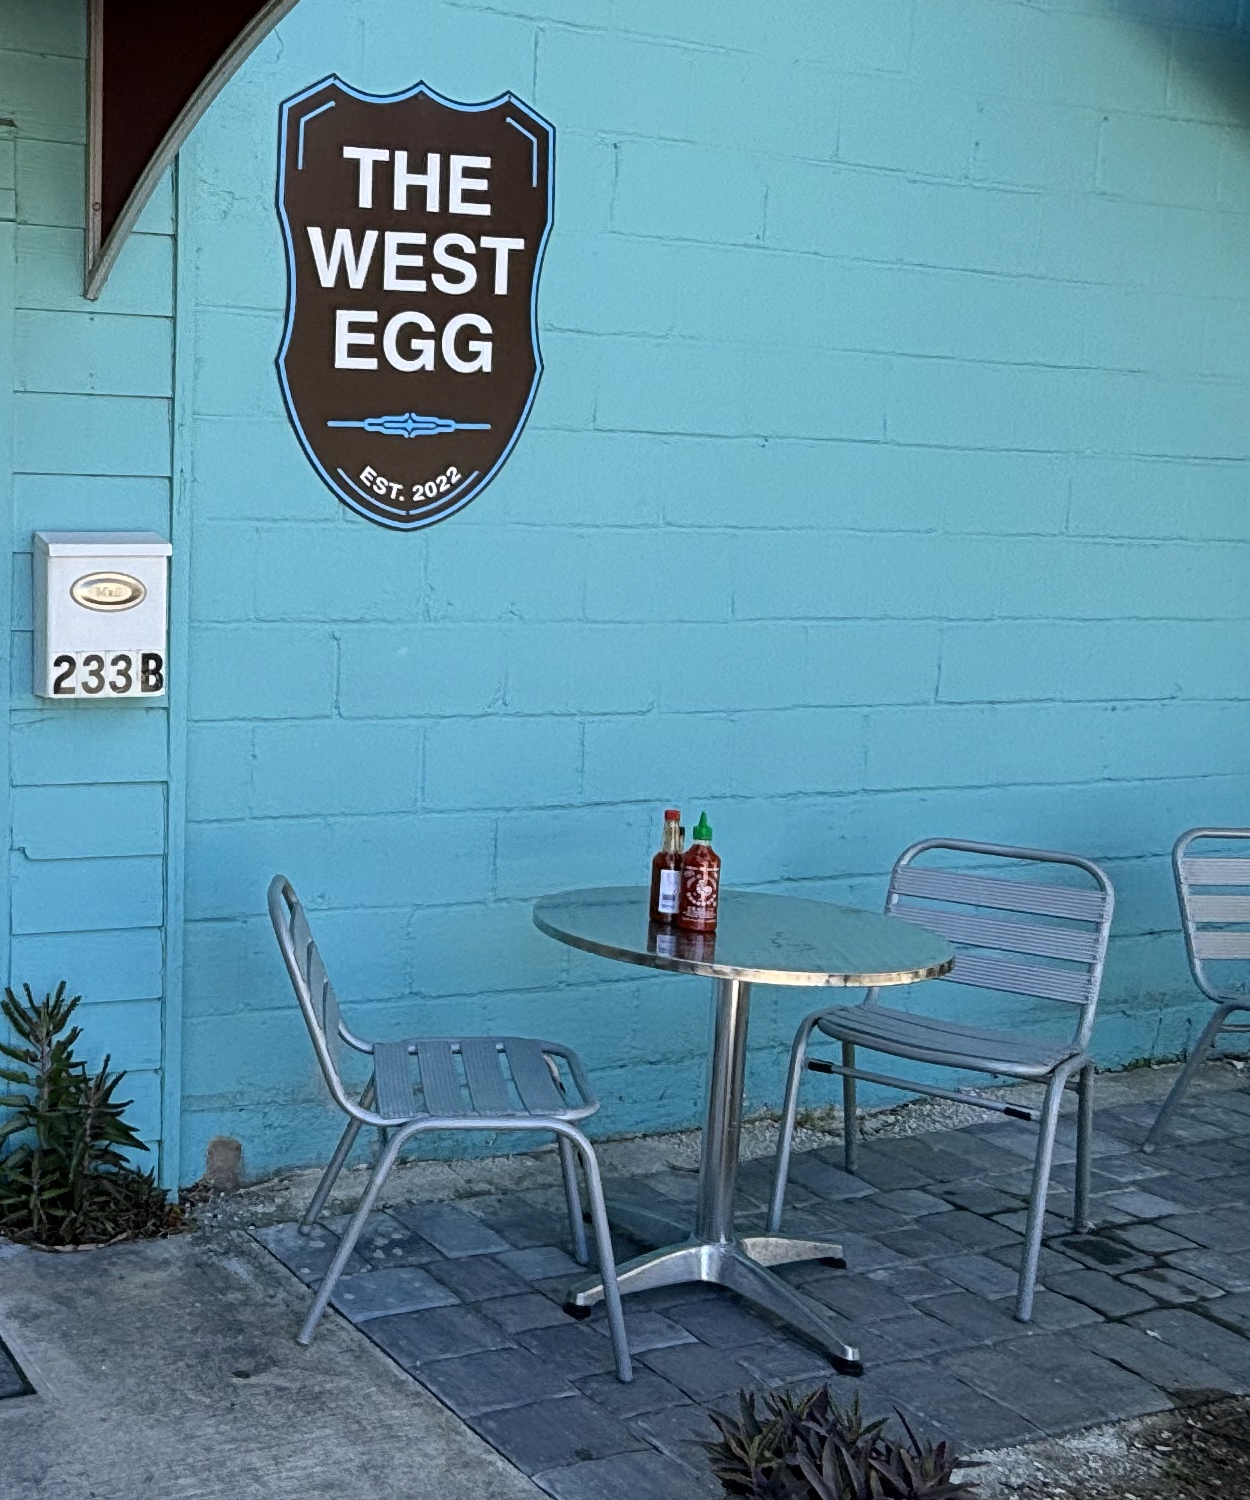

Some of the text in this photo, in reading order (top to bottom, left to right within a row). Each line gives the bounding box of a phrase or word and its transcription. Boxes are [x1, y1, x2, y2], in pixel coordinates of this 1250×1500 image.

[342, 146, 492, 216] THE
[307, 226, 525, 296] WEST
[334, 309, 493, 374] EGG
[359, 465, 462, 502] EST. 2022
[53, 652, 164, 695] 233B
